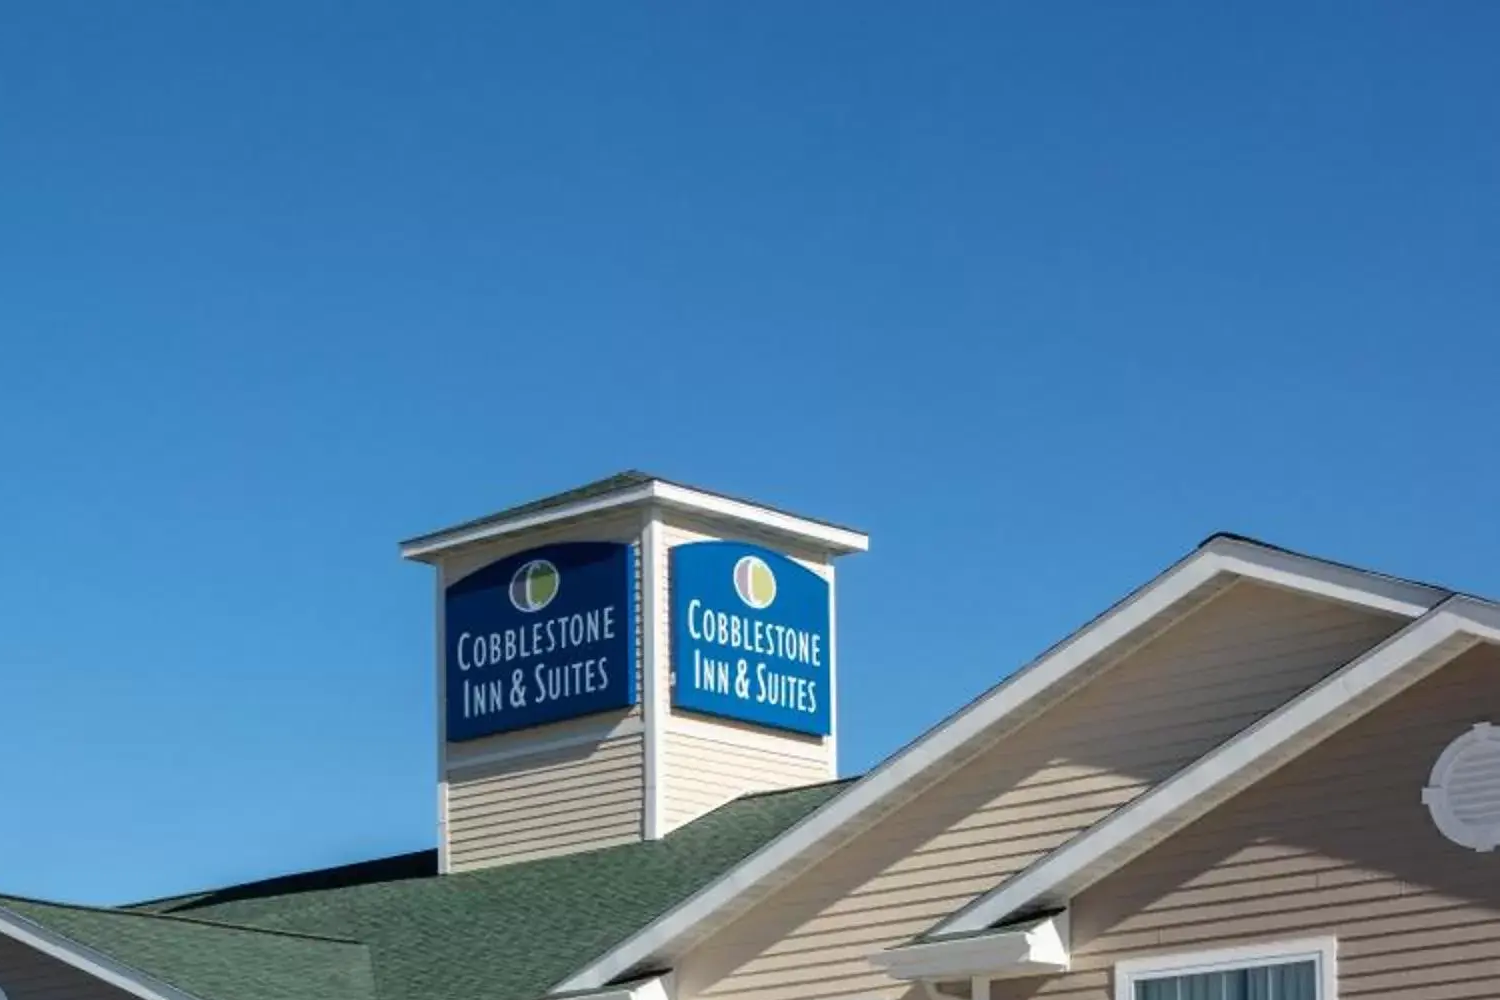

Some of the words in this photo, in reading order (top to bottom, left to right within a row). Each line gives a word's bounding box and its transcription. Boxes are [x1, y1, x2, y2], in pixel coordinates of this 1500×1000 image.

[457, 605, 615, 671] COBBLESTONE
[688, 599, 821, 667] COBBLESTONE
[463, 678, 503, 719] INN
[509, 668, 527, 708] &
[534, 656, 609, 704] SUITES
[694, 648, 730, 696] INN
[734, 657, 750, 700] &
[756, 662, 817, 714] SUITES
